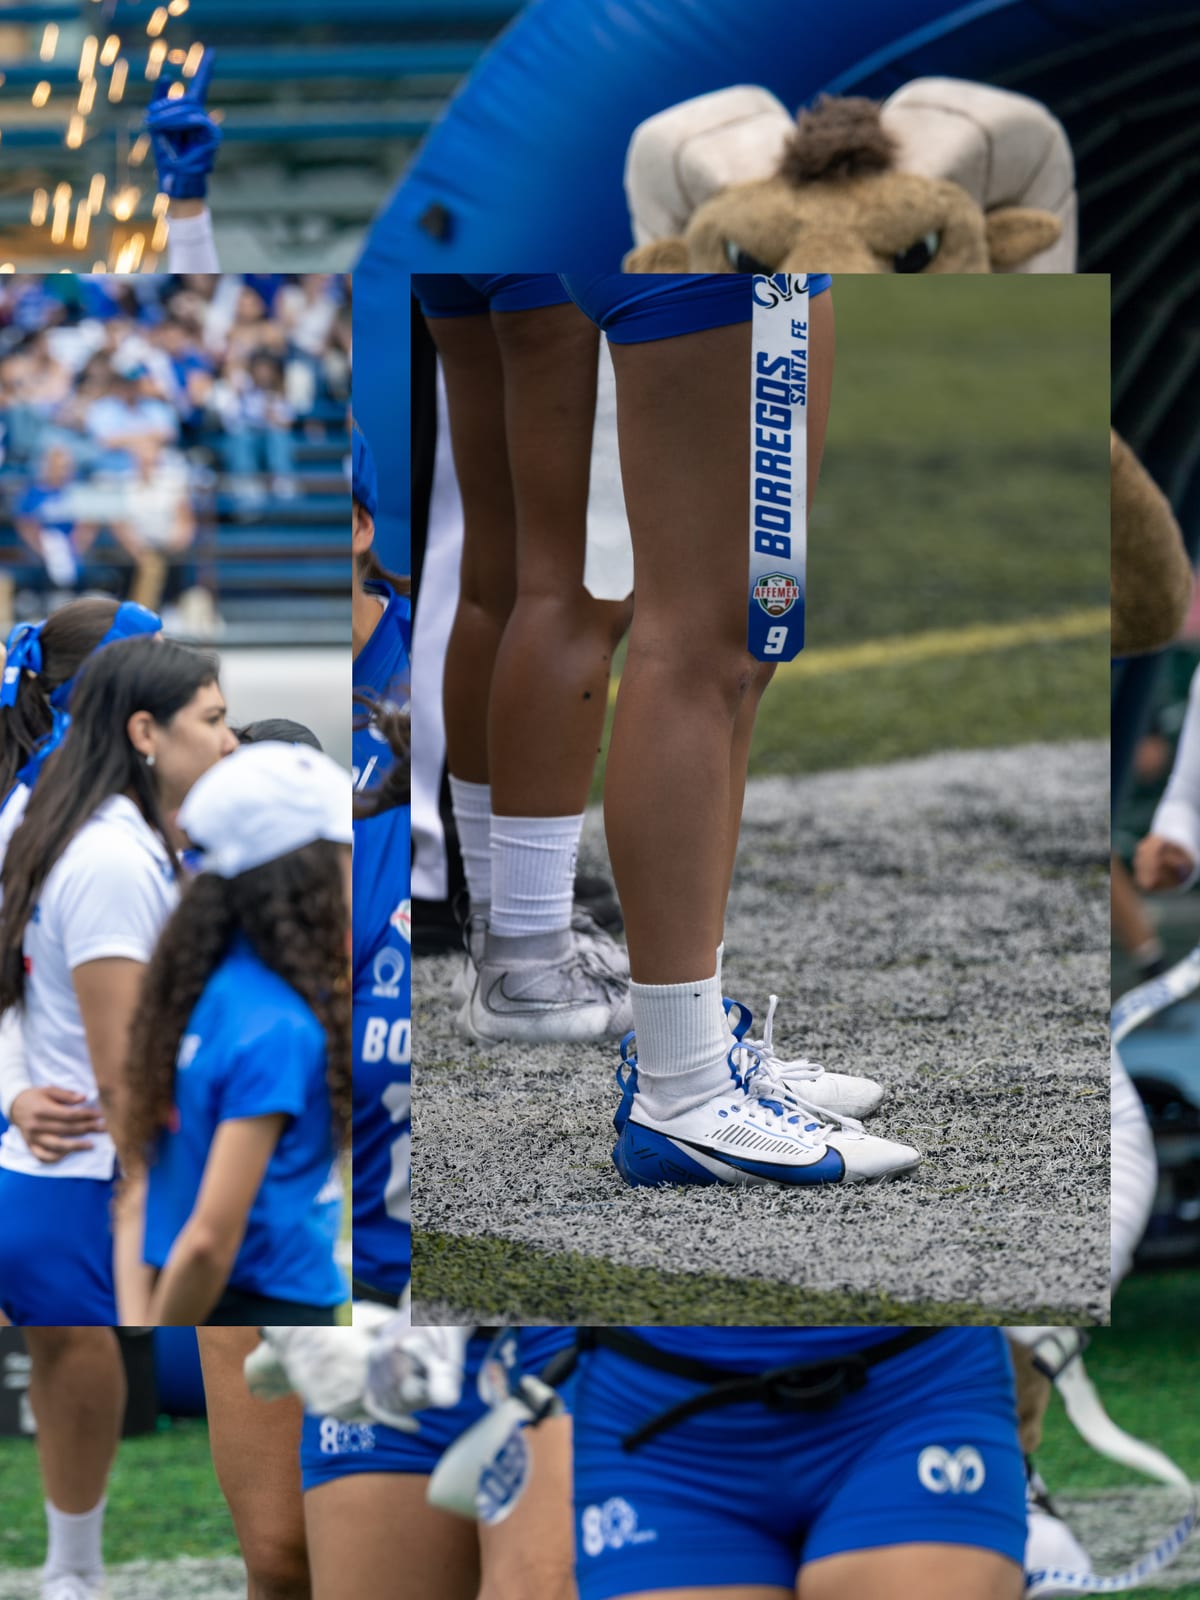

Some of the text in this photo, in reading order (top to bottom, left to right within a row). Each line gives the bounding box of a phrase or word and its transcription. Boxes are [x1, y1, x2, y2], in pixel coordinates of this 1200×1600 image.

[790, 318, 808, 407] SANTA FE
[754, 351, 792, 561] BORREGOS
[754, 587, 798, 599] AFFEMEX
[763, 626, 789, 655] 9
